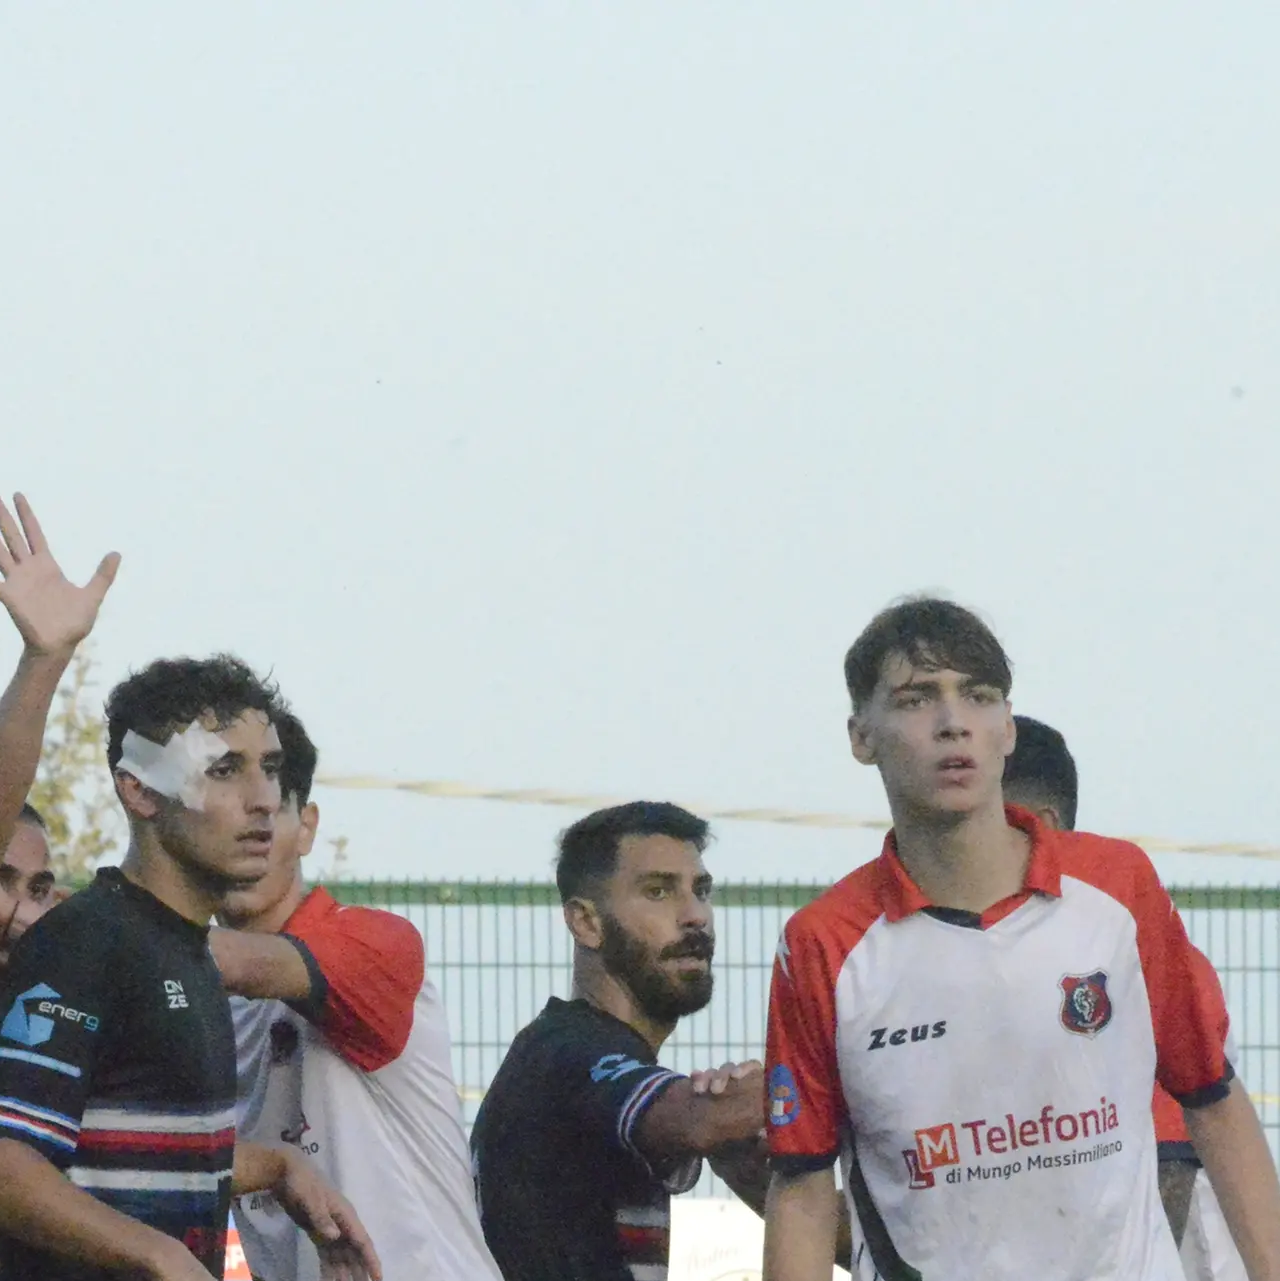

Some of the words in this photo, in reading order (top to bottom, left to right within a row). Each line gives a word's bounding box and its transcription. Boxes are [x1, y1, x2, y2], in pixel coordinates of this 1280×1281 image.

[867, 1020, 947, 1052] Zeus
[961, 1096, 1120, 1156] Telefonia
[946, 1169, 961, 1184] di
[967, 1161, 1021, 1180] Mungo
[1027, 1139, 1123, 1172] Massimiliano
